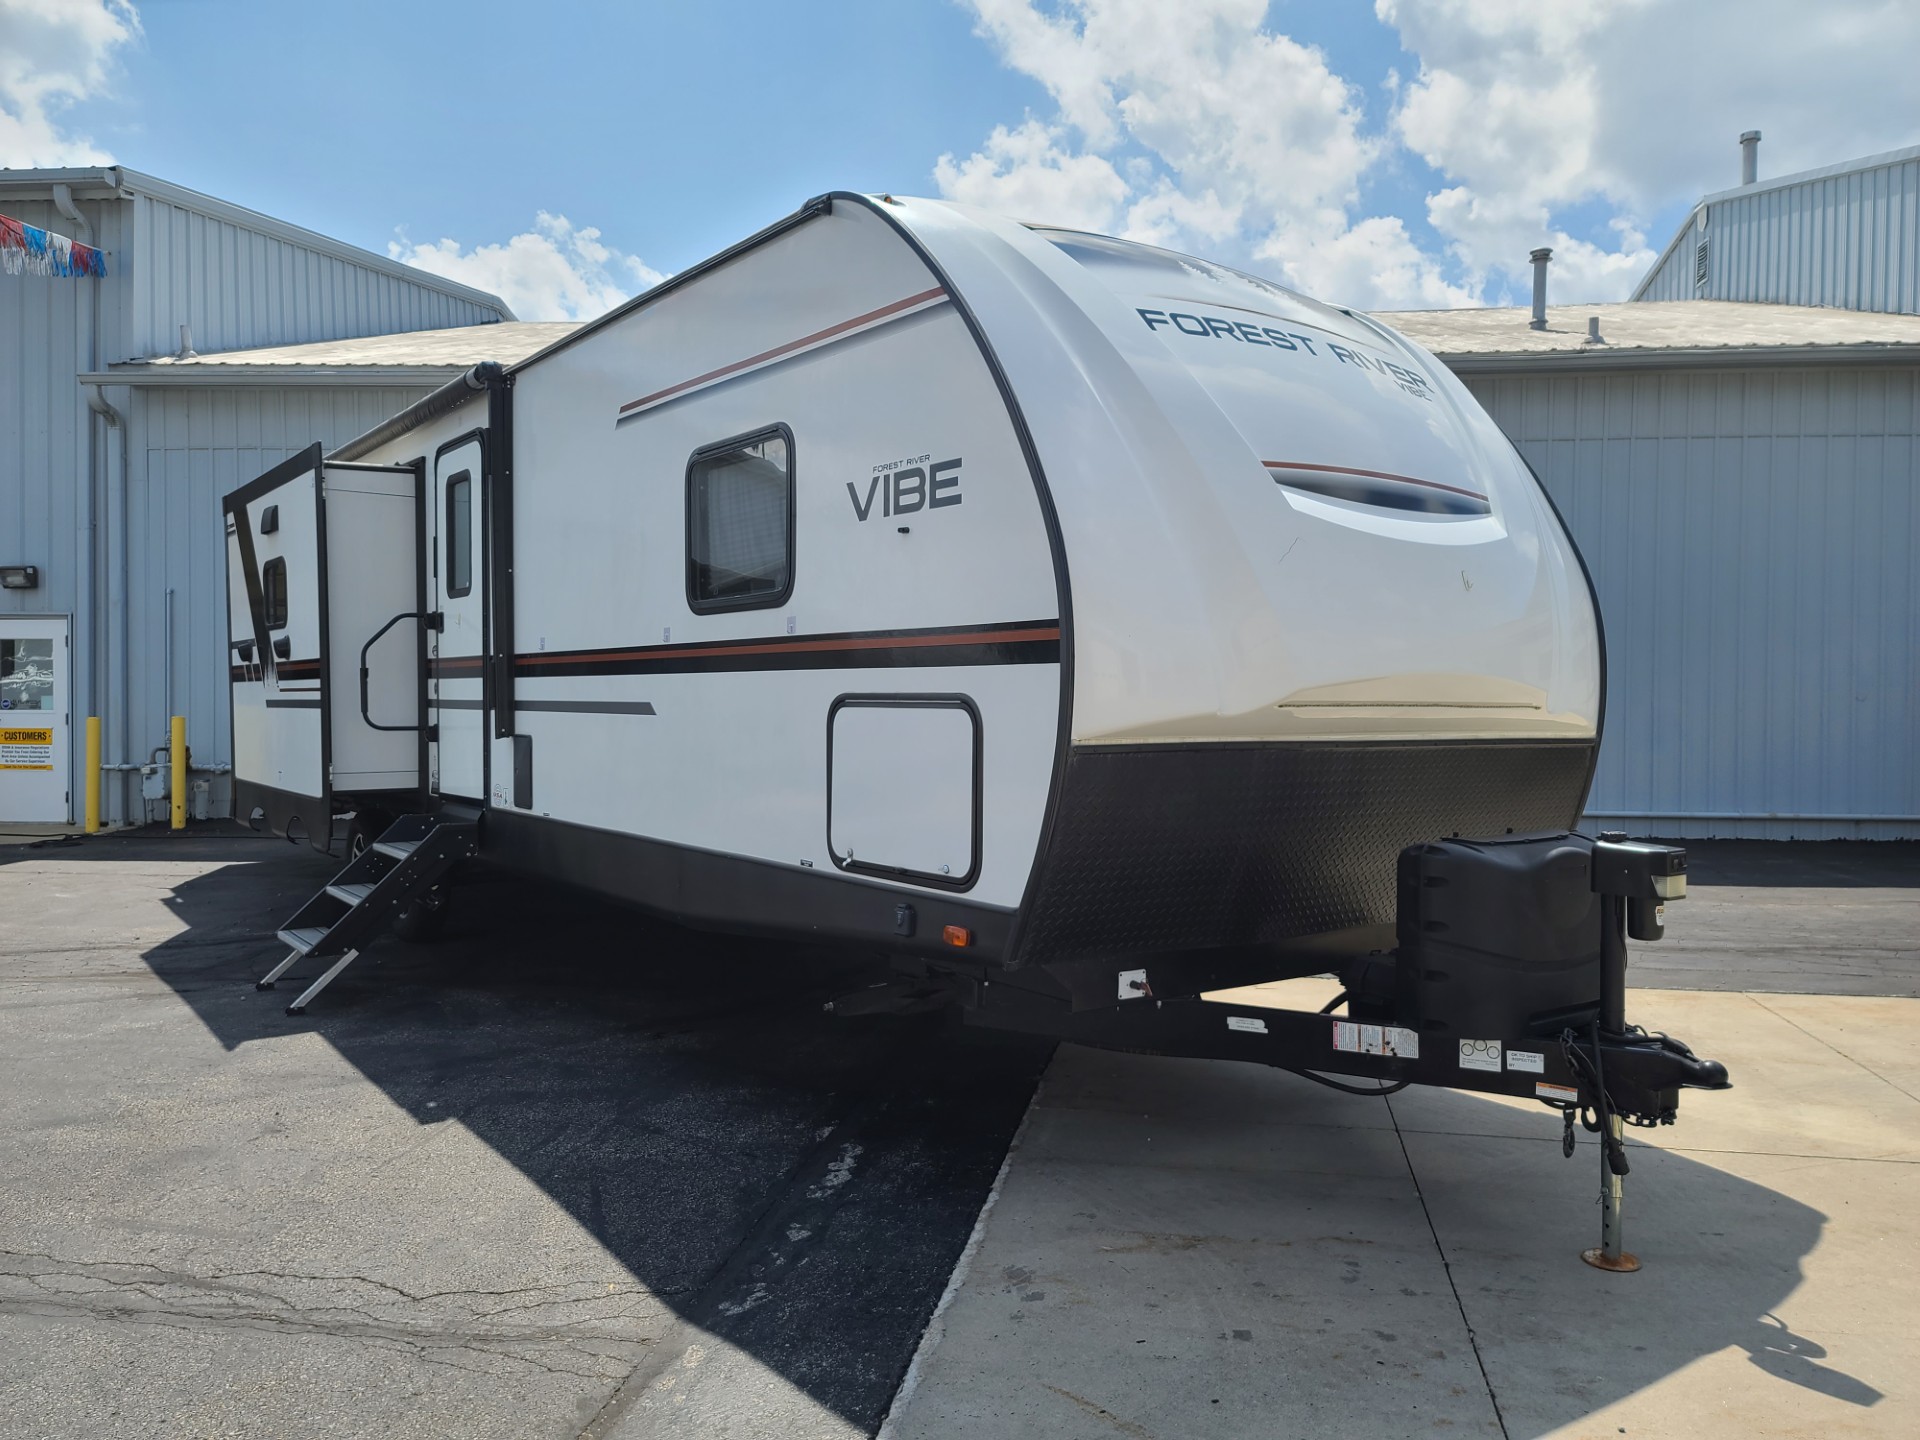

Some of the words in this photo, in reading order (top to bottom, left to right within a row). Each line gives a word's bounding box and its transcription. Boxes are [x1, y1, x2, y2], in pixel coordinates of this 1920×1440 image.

[1135, 308, 1318, 356] FOREST
[1326, 342, 1435, 394] RIVER
[1392, 379, 1433, 402] VIBE
[872, 460, 904, 474] FOREST
[906, 454, 931, 467] RIVER
[846, 457, 963, 522] VIBE
[4, 731, 47, 741] CUSTOMERS
